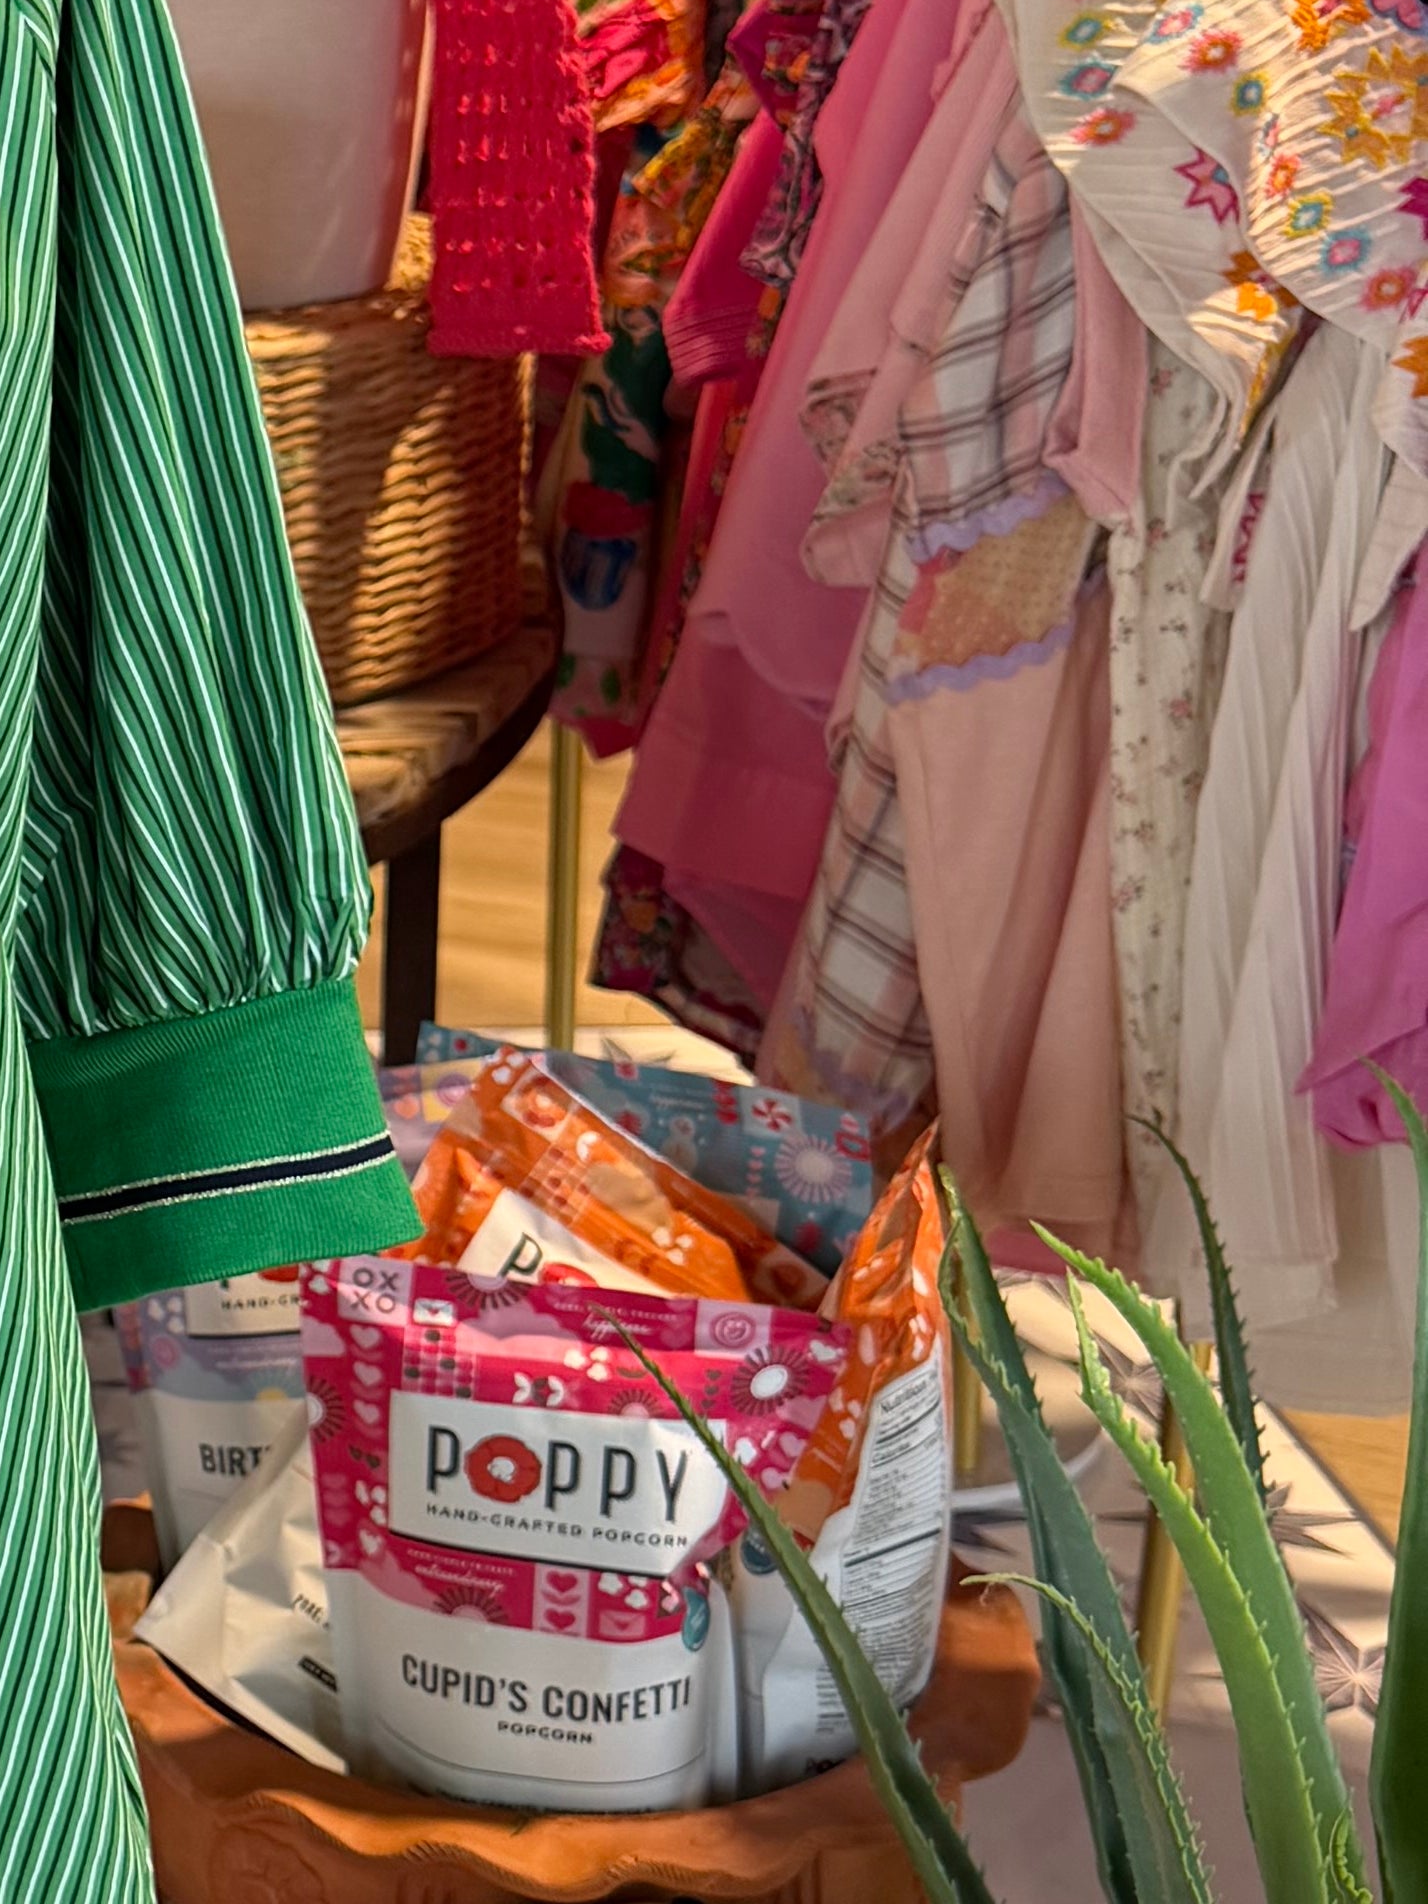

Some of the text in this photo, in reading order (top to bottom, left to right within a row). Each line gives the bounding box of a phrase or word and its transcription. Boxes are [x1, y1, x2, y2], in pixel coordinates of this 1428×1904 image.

[426, 1424, 688, 1524] POPPY
[426, 1503, 688, 1548] HAND-CRAFTED POPCORN
[401, 1653, 528, 1714] CUPID'S
[542, 1675, 692, 1723] CONFETTI
[497, 1719, 593, 1744] POPCORN
